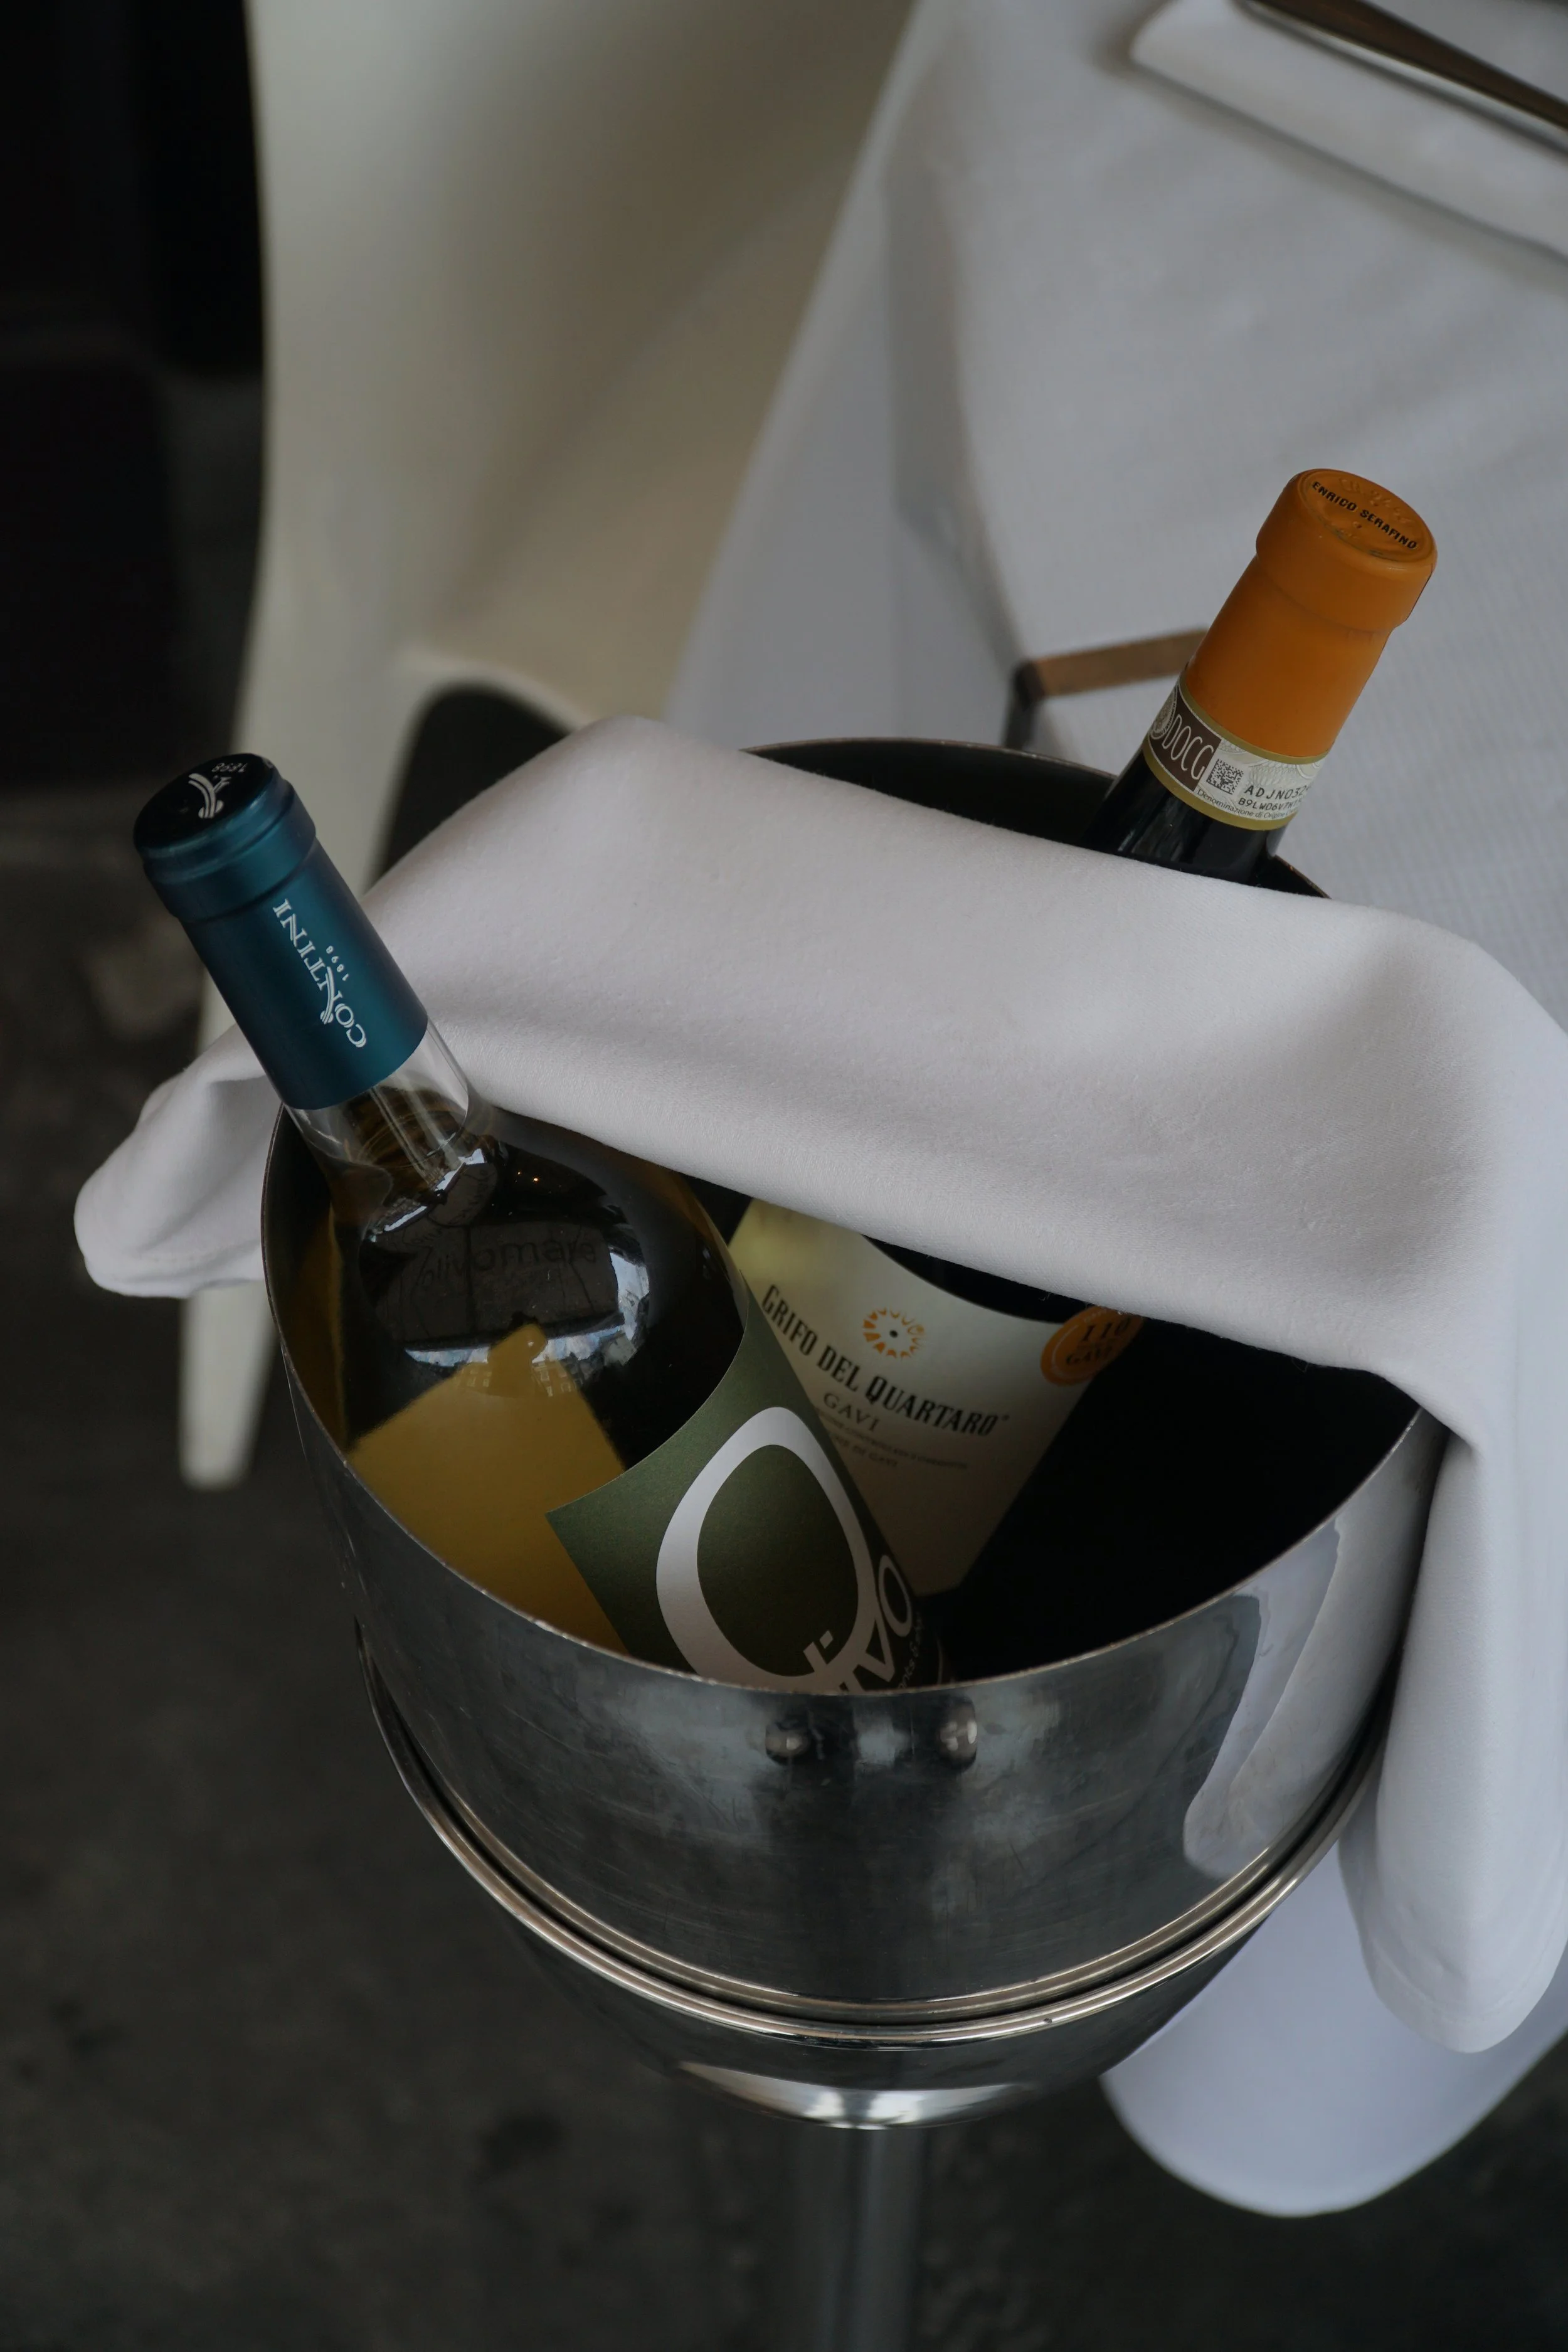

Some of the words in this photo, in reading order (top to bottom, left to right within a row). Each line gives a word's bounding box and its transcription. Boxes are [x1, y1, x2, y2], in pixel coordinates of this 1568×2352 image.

[1312, 480, 1357, 512] ENRICO
[1360, 509, 1418, 549] SERAFINO
[1161, 714, 1214, 780] DOCG
[1197, 788, 1254, 818] Denominazione
[273, 898, 367, 1047] CONTINI
[326, 945, 350, 982] 1898
[760, 1284, 818, 1356] GRIFO
[816, 1345, 859, 1393] DEL
[823, 1392, 881, 1433] GAVI
